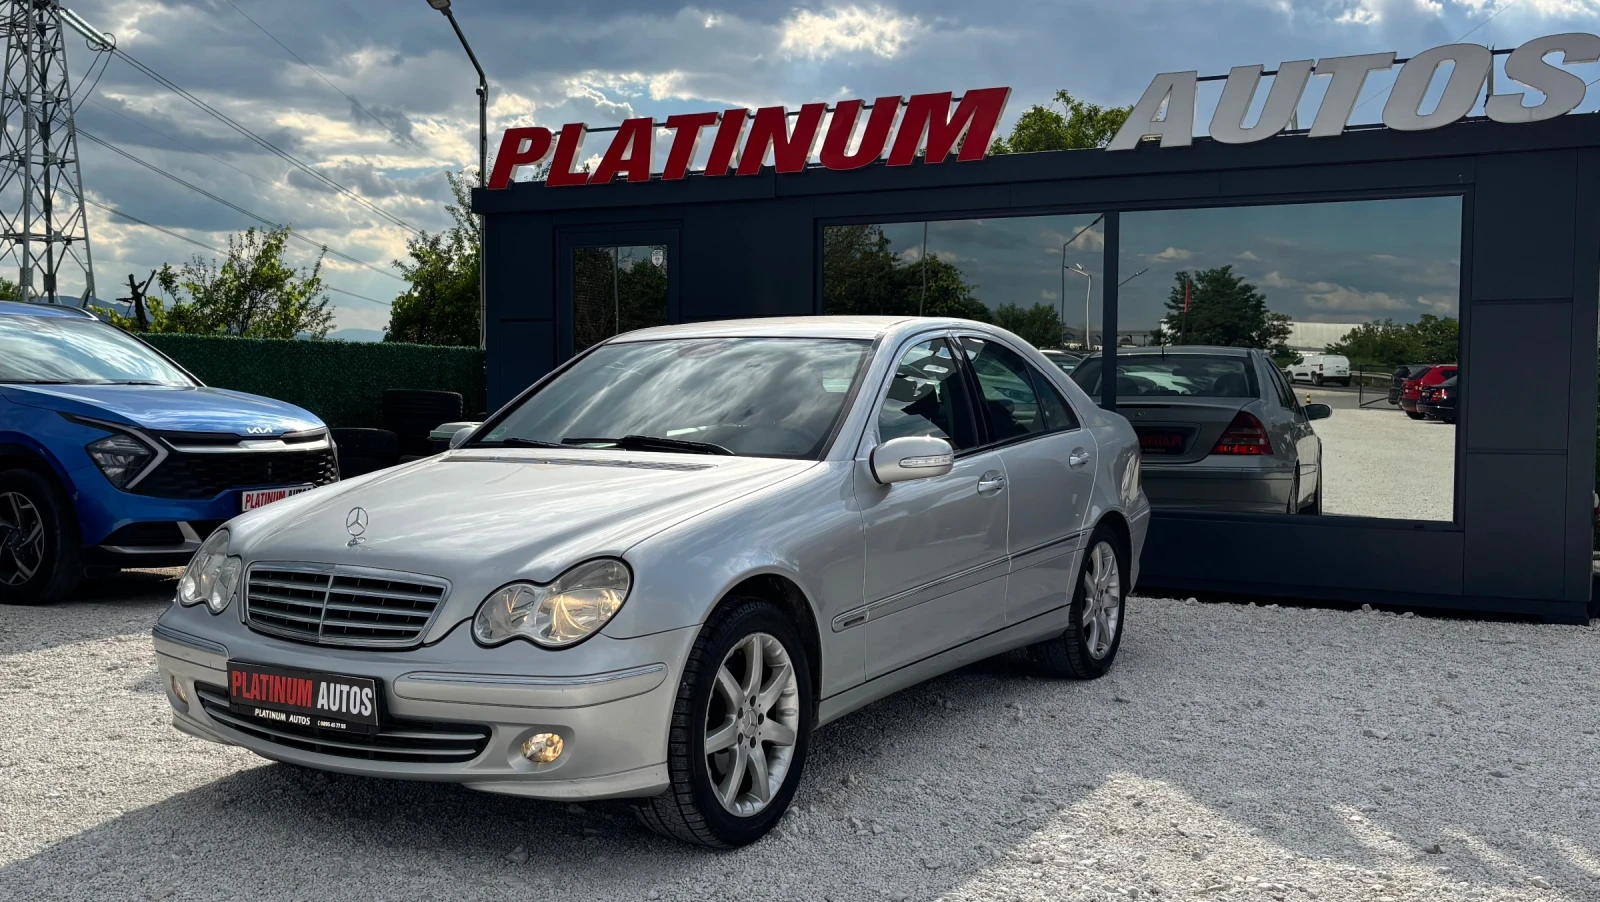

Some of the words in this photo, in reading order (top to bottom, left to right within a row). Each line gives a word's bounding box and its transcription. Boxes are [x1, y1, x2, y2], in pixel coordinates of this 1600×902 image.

[487, 86, 1012, 190] PLATINUM
[1105, 33, 1600, 151] AUTOS
[246, 426, 273, 434] KIA
[231, 671, 313, 708] PLATINUM
[316, 682, 373, 717] AUTOS
[254, 708, 287, 721] PLATINUM
[289, 714, 311, 726] AUTOS
